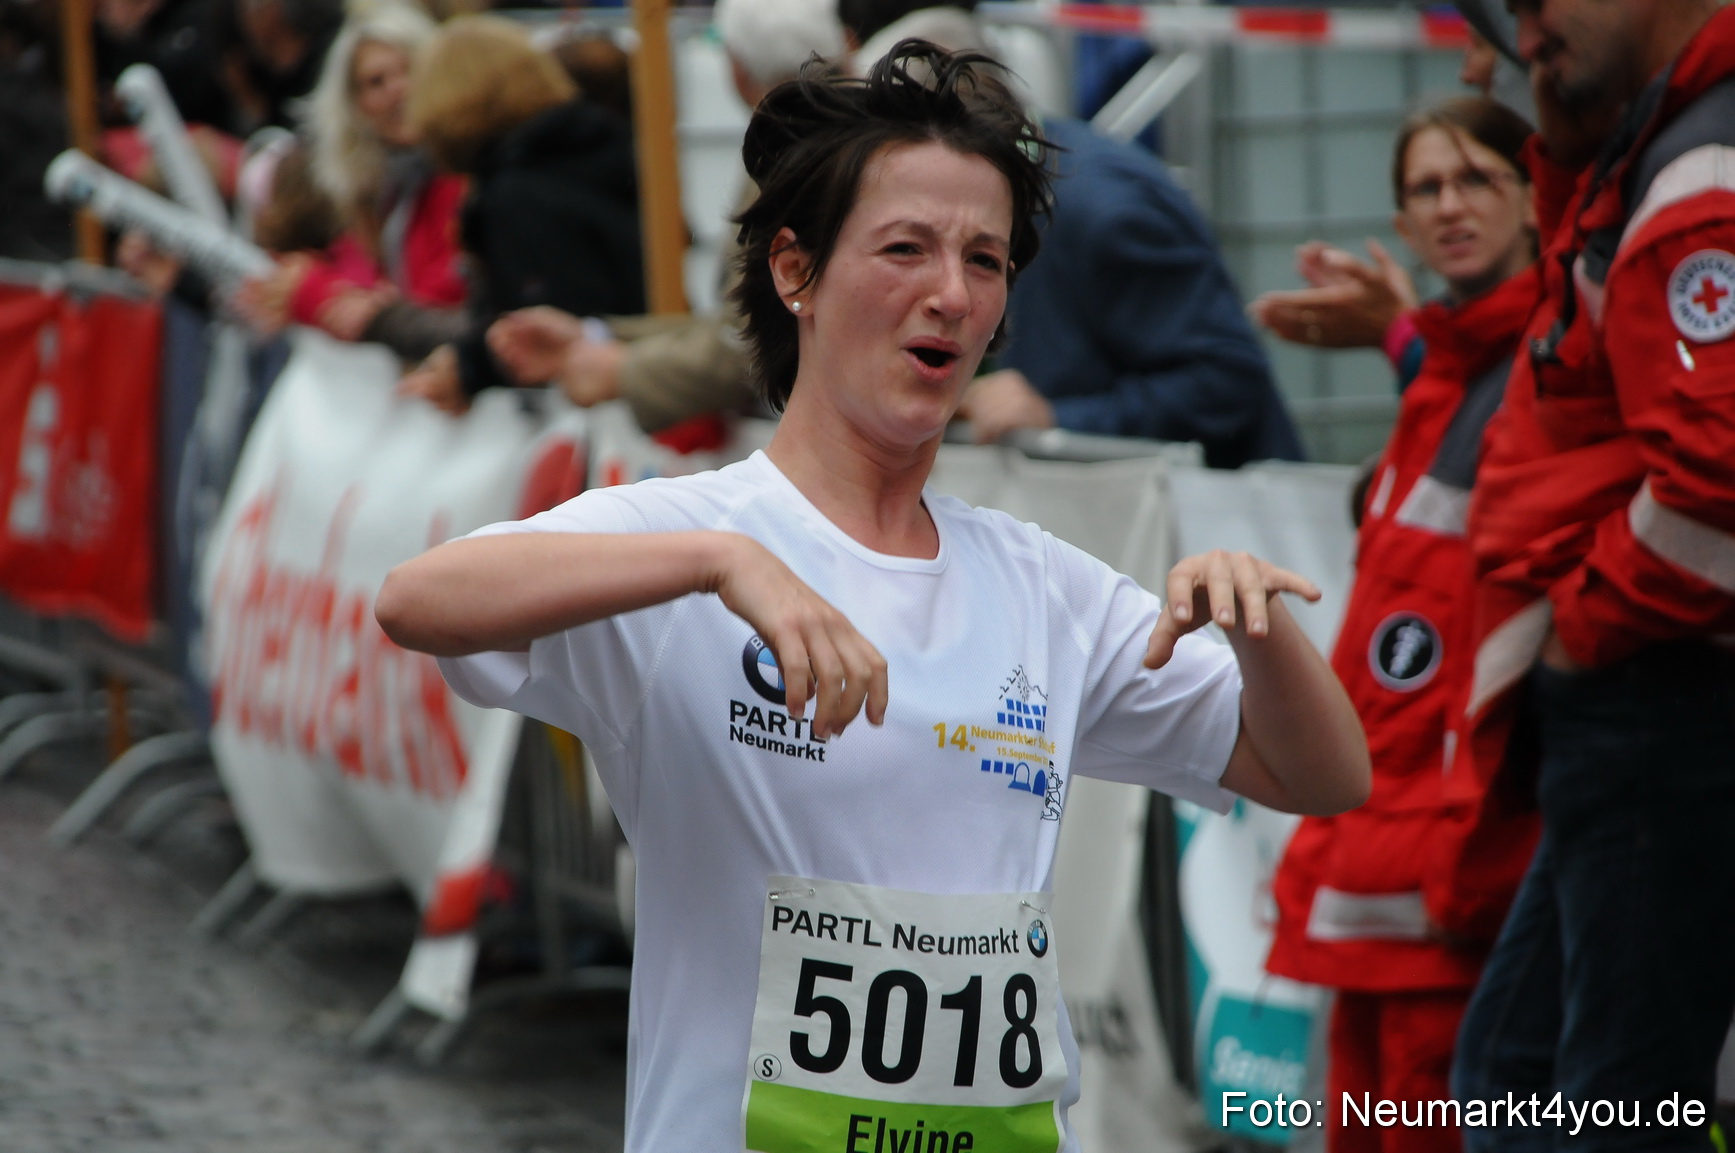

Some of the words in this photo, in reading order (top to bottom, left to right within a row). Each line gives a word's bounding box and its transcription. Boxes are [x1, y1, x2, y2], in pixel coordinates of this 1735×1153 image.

[730, 699, 826, 744] PARTL
[933, 722, 976, 752] 14.
[971, 725, 1037, 747] Neumarkter
[729, 725, 826, 762] Neumarkt
[771, 905, 882, 948] PARTL
[892, 923, 1020, 956] Neumarkt
[789, 957, 1043, 1089] 5018
[761, 1058, 773, 1078] S
